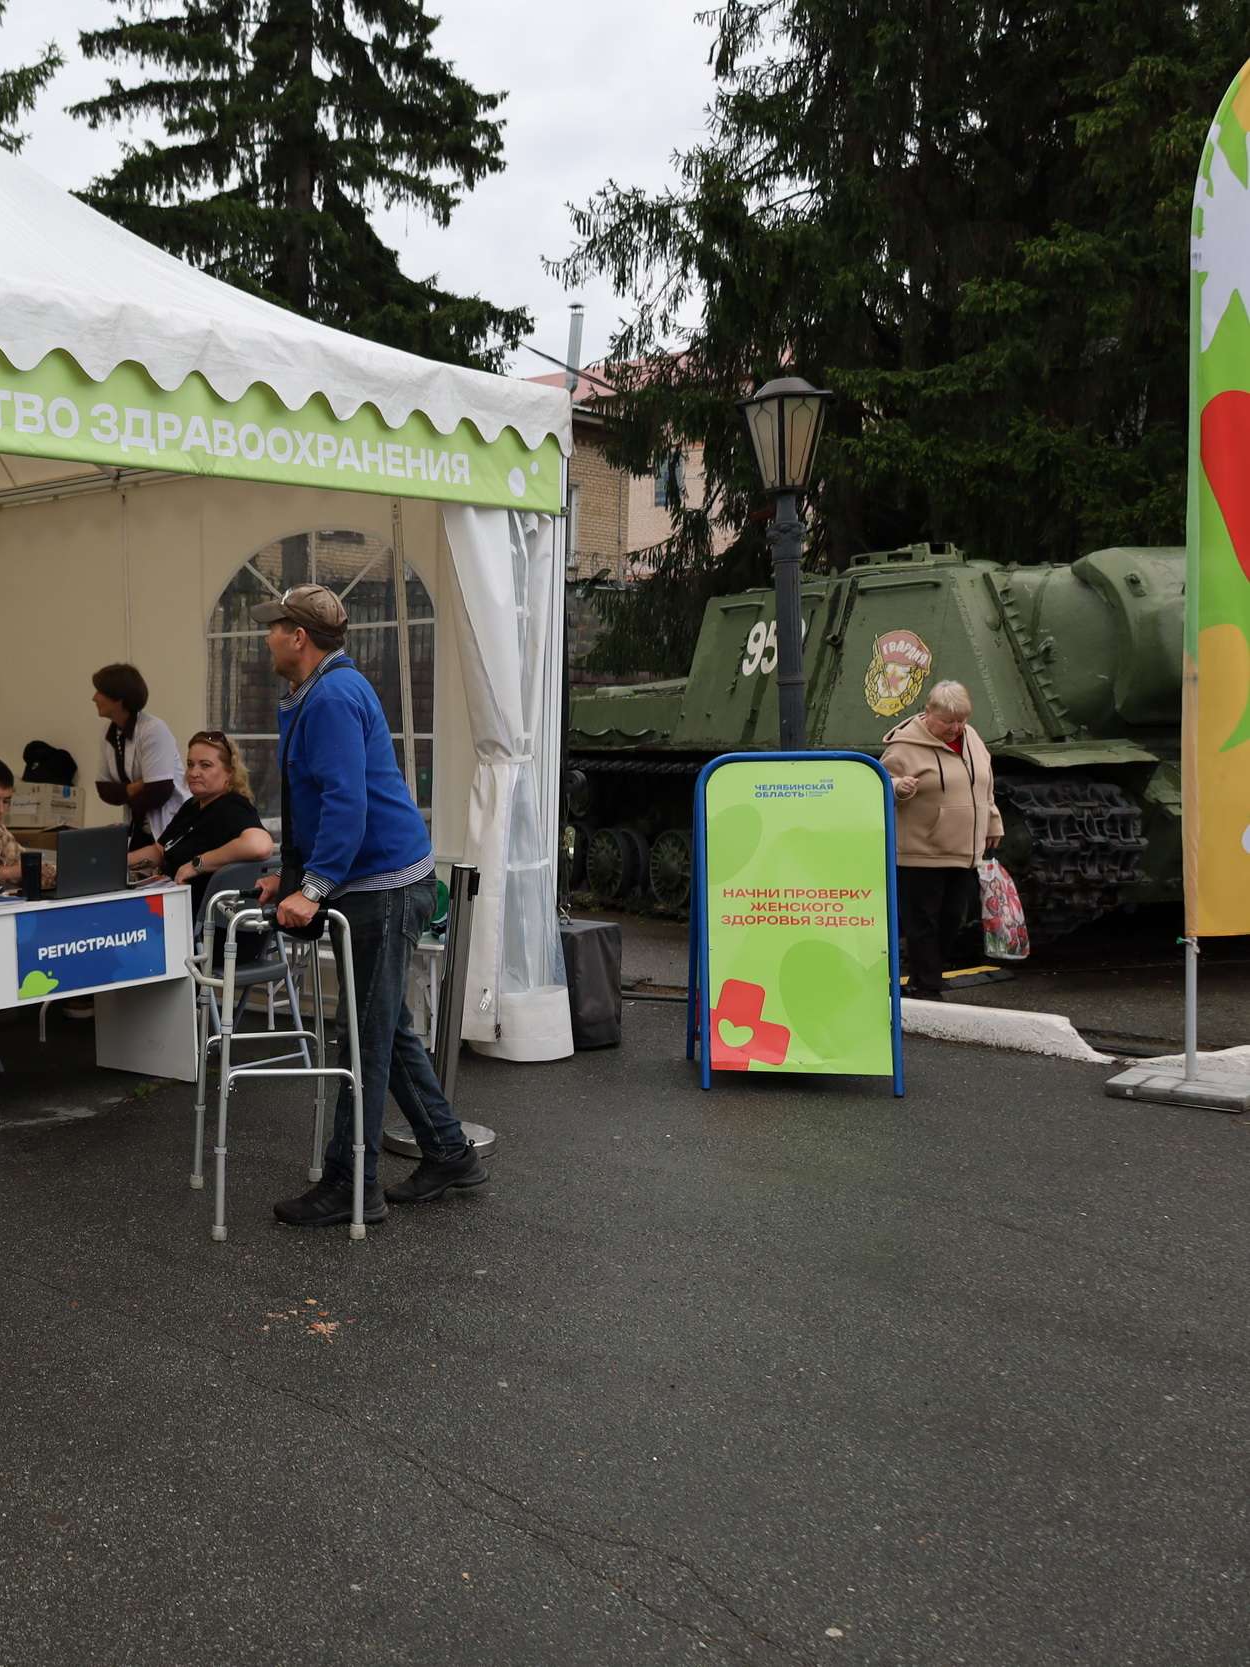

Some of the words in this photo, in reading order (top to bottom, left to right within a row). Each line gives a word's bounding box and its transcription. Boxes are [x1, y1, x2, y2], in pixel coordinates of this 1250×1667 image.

[89, 402, 472, 486] ЗДРАВООХРАНЕНИЯ
[883, 640, 929, 665] ГВАРДИЯ
[754, 783, 834, 791] ЧЕЛЯБИНСКАЯ
[723, 888, 779, 898] НАЧНИ
[784, 888, 872, 899] ПРОВЕРКУ
[750, 902, 844, 912] ЖЕНСКОГО
[721, 915, 810, 926] ЗДОРОВЬЯ
[815, 915, 875, 927] ЗДЕСЬ!
[37, 928, 147, 960] РЕГИСТРАЦИЯ
